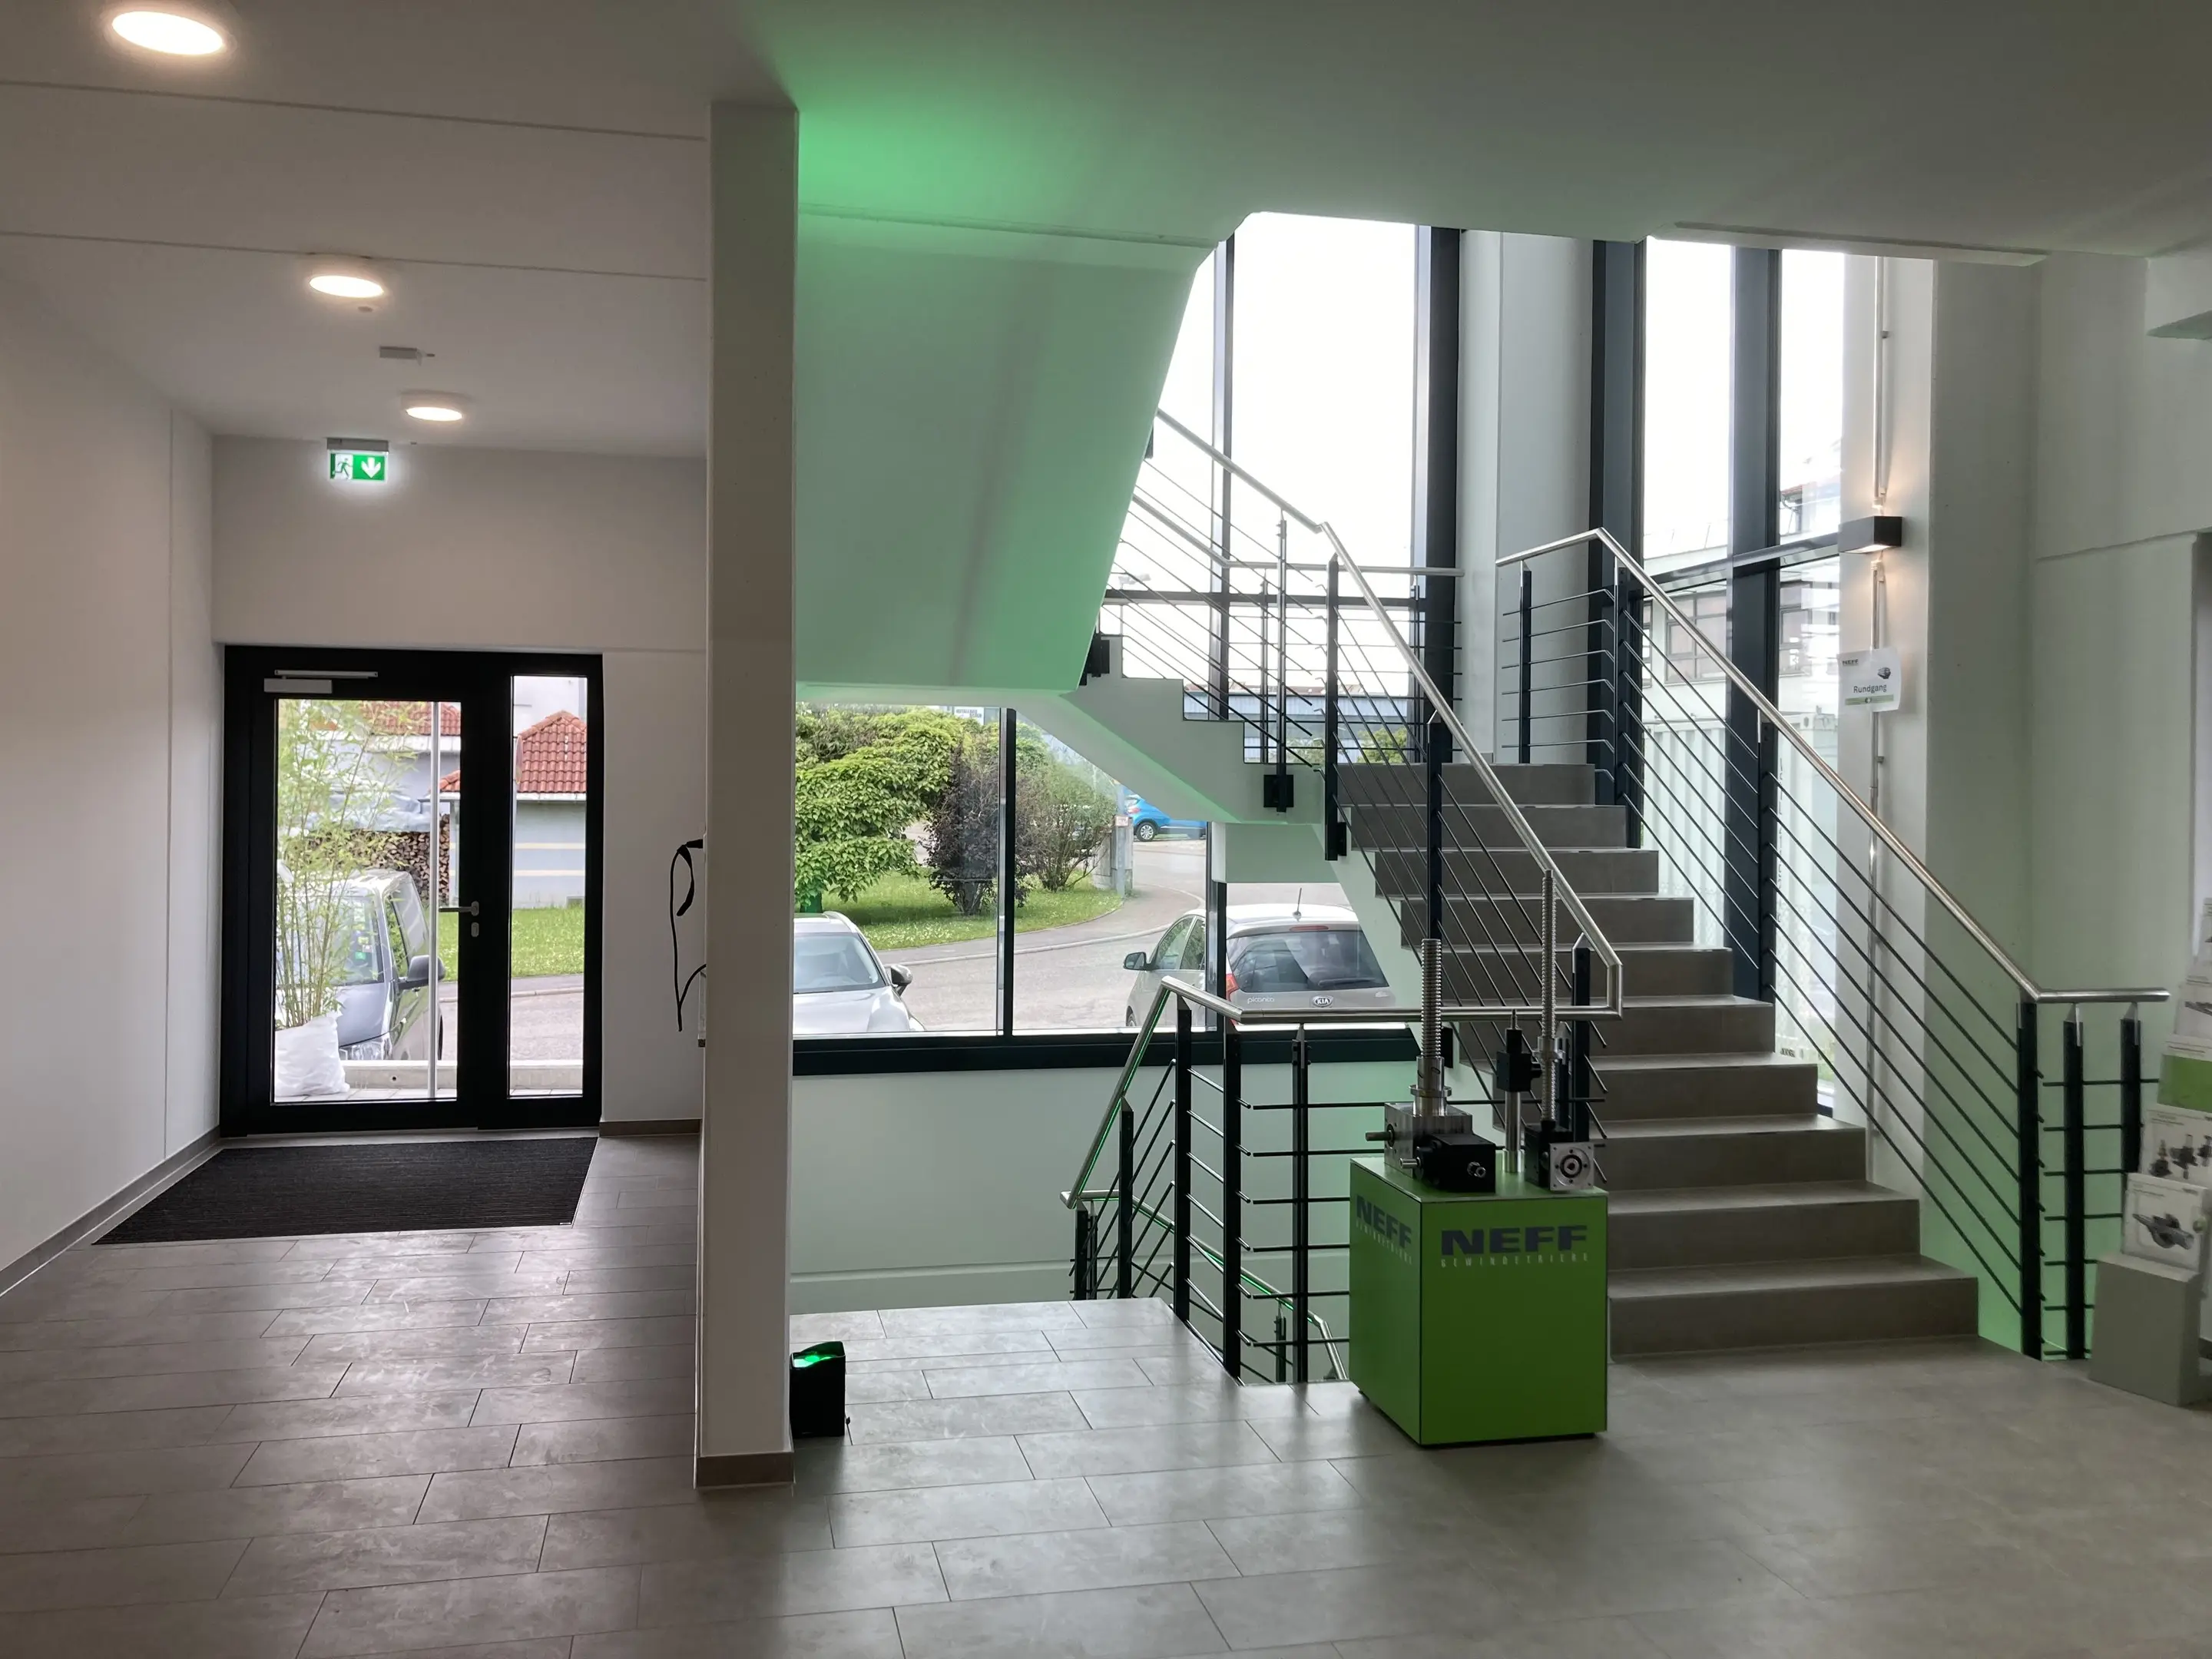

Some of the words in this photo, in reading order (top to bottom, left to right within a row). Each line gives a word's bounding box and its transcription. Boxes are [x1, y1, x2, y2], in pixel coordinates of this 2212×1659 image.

[1853, 684, 1887, 694] Rundgang
[1356, 1194, 1412, 1249] NEFF
[1441, 1225, 1588, 1256] NEFF
